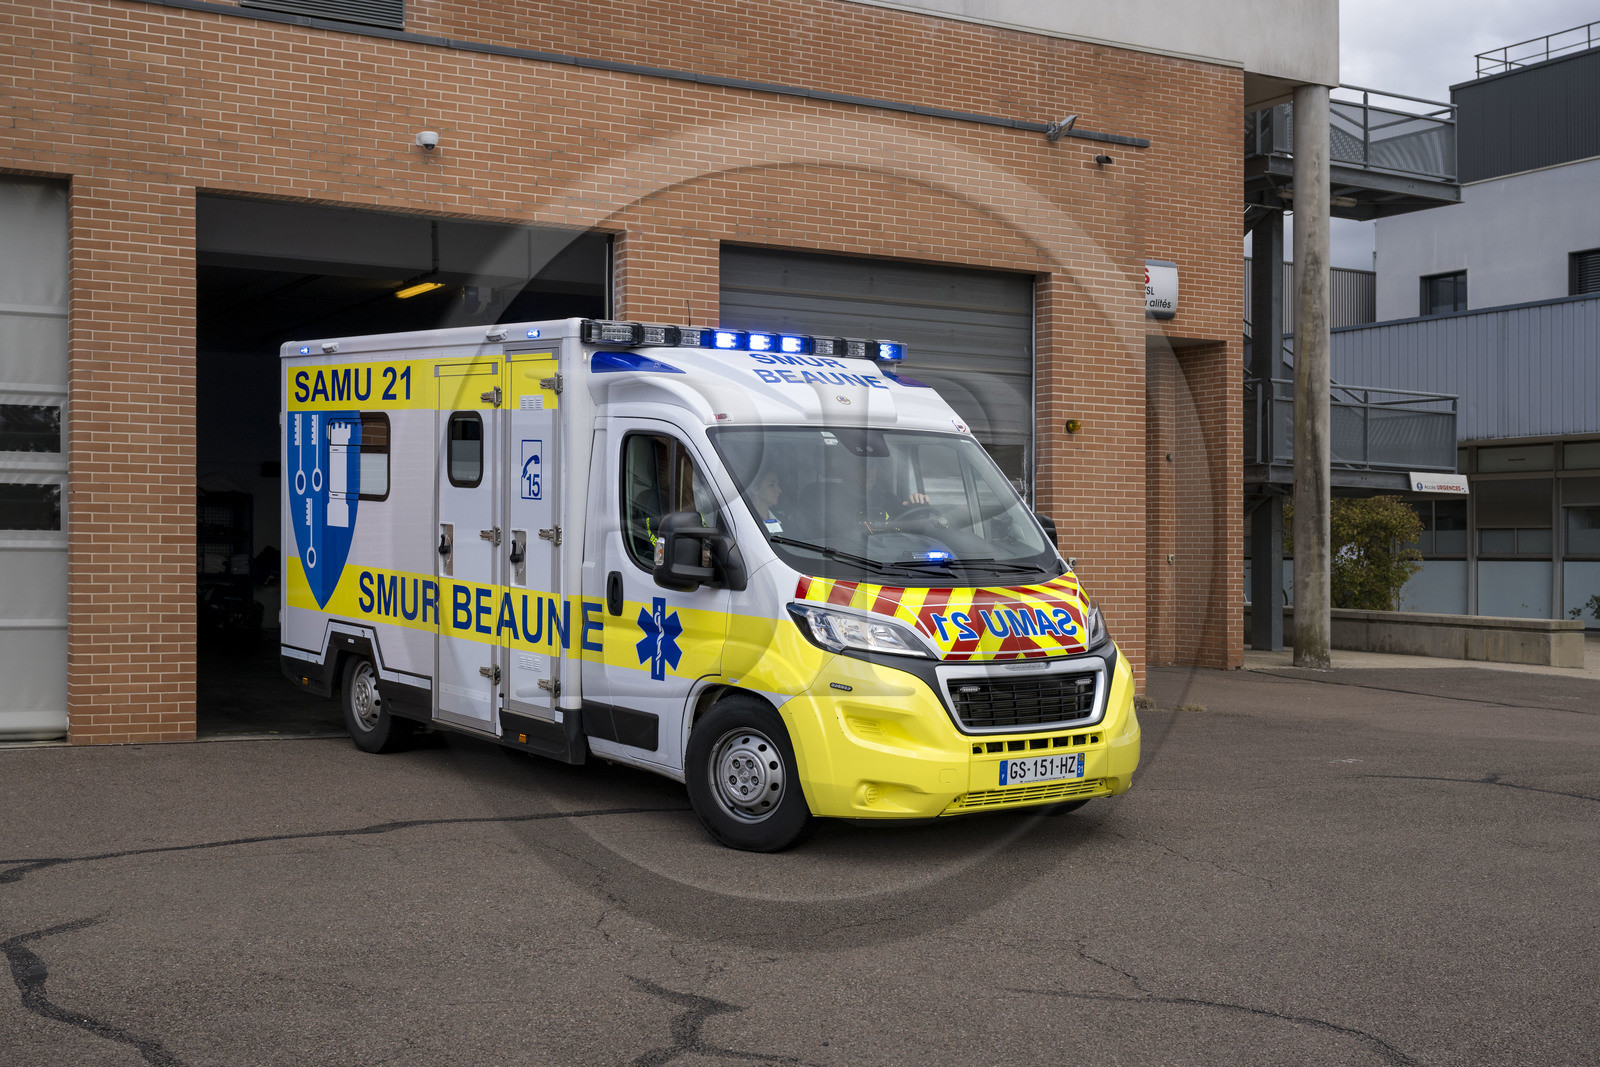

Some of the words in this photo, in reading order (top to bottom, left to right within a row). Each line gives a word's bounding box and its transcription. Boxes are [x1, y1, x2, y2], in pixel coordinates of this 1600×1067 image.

[1145, 287, 1154, 295] SL
[750, 353, 848, 369] SMUR
[294, 367, 372, 403] SAMU
[382, 366, 412, 400] 21
[753, 369, 889, 390] BEAUNE
[526, 473, 541, 498] 15
[358, 570, 441, 626] SMUR
[452, 584, 604, 653] BEAUNE
[1010, 755, 1076, 780] GS-151-HZ
